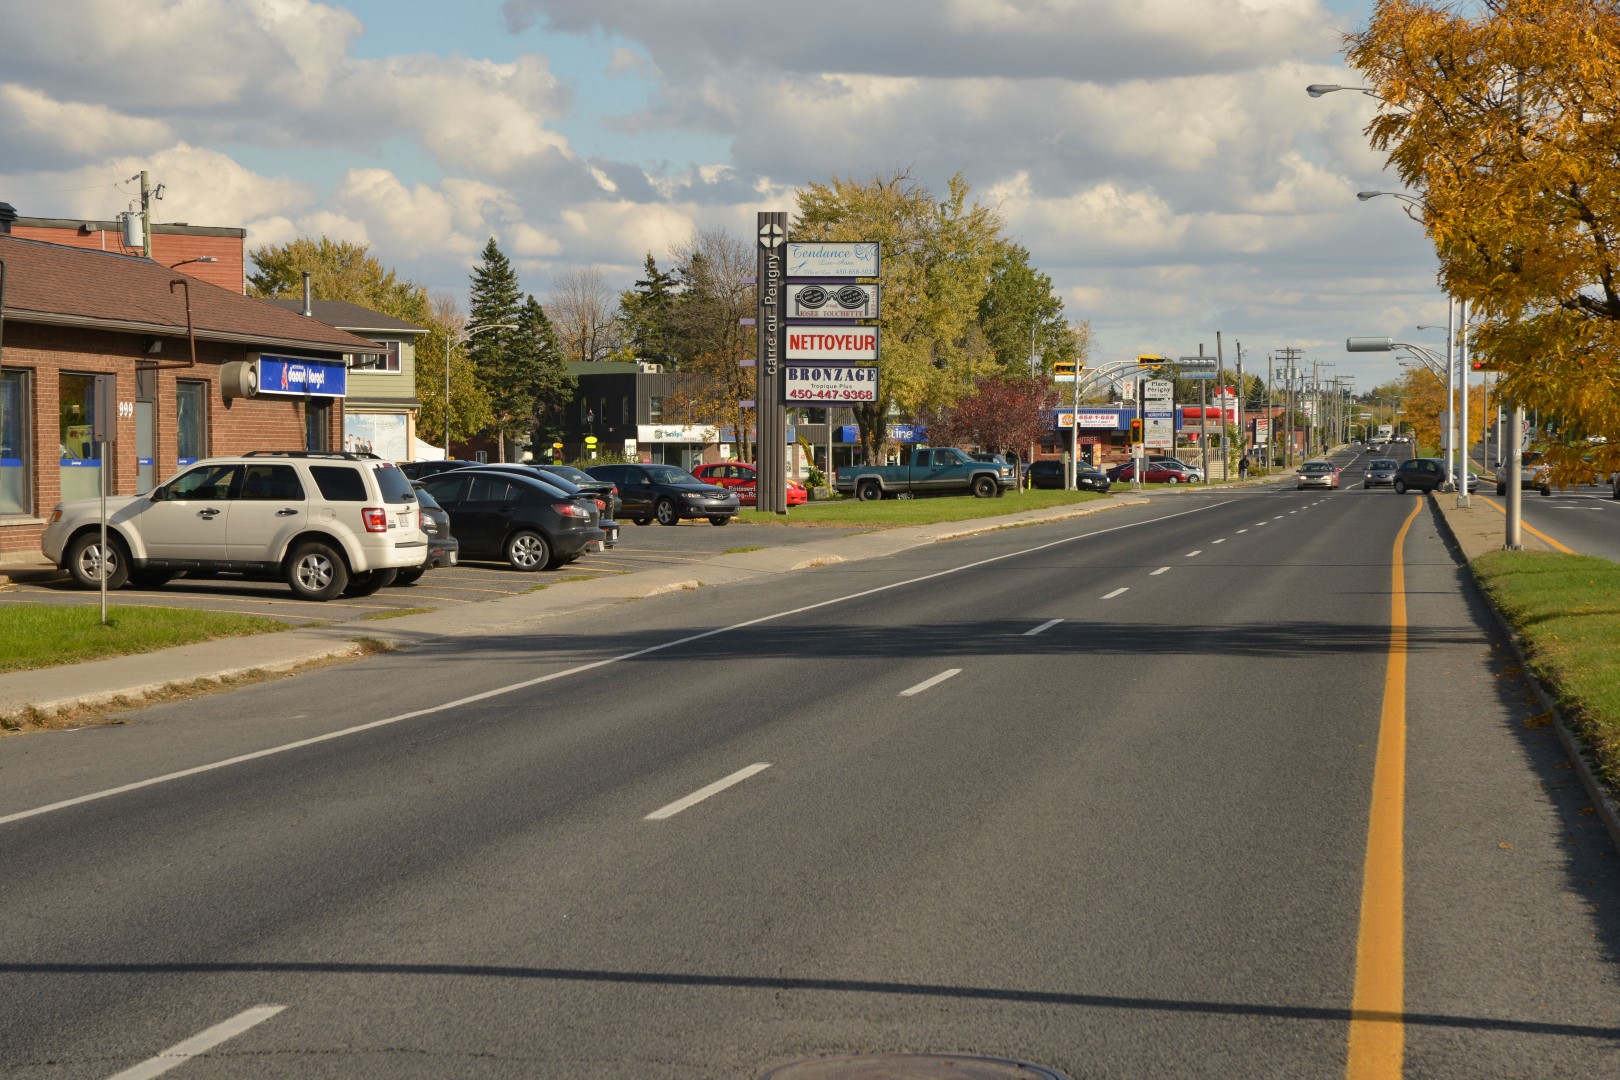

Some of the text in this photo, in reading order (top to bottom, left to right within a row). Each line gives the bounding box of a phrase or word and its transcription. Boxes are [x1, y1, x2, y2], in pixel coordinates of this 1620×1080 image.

[789, 244, 851, 259] Tendance
[764, 253, 780, 305] Perigny
[789, 334, 876, 351] NETTOYEUR
[788, 368, 876, 382] BRONZAGE
[789, 389, 873, 400] 450-447-9368
[119, 401, 134, 417] 999
